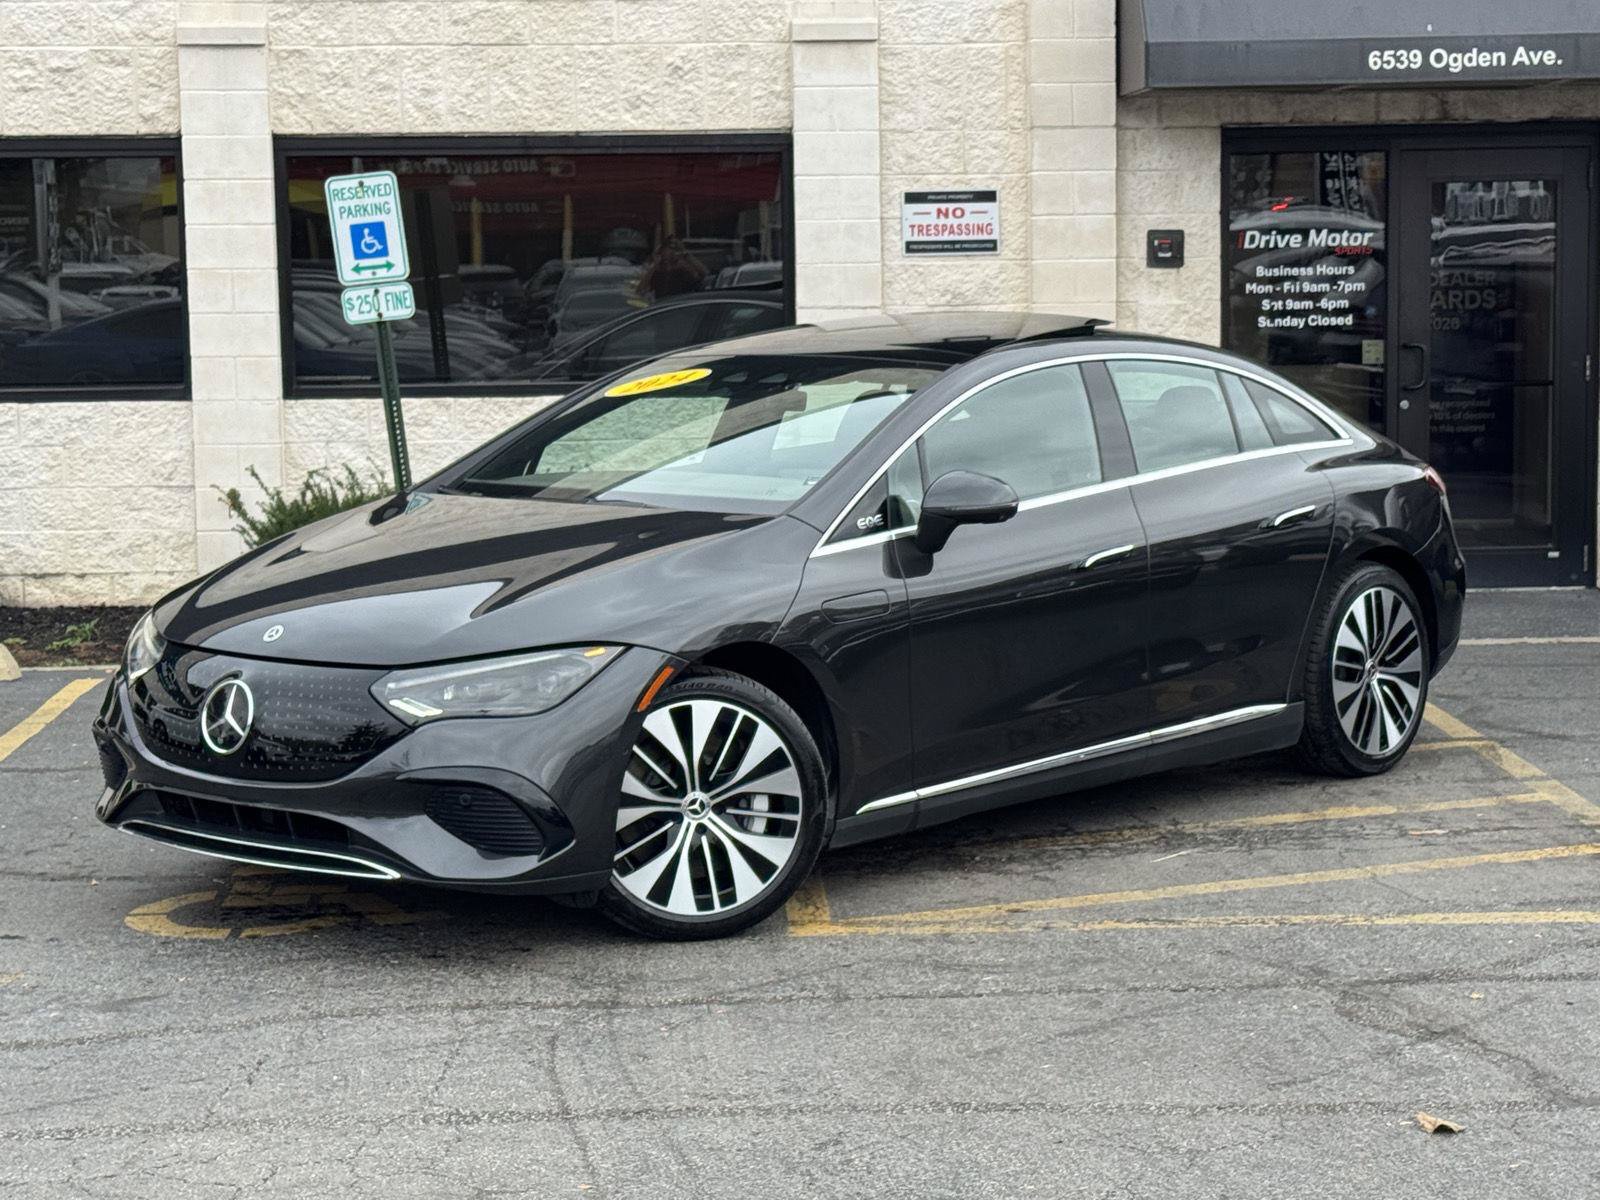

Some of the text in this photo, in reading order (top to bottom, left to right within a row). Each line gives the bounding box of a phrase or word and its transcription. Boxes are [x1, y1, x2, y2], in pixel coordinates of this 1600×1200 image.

[1368, 46, 1563, 73] 6539 Ogden Ave.
[332, 183, 392, 201] RESERVED
[338, 201, 392, 219] PARKING
[936, 206, 966, 219] NO
[909, 223, 994, 237] TRESPASSING
[1308, 229, 1374, 248] Motor
[1256, 264, 1355, 278] Business Hours
[1245, 282, 1273, 294] Mon
[1302, 281, 1330, 293] 9am
[384, 290, 412, 312] FINE
[1285, 298, 1314, 310] 9am
[1257, 313, 1353, 329] Sunday Closed
